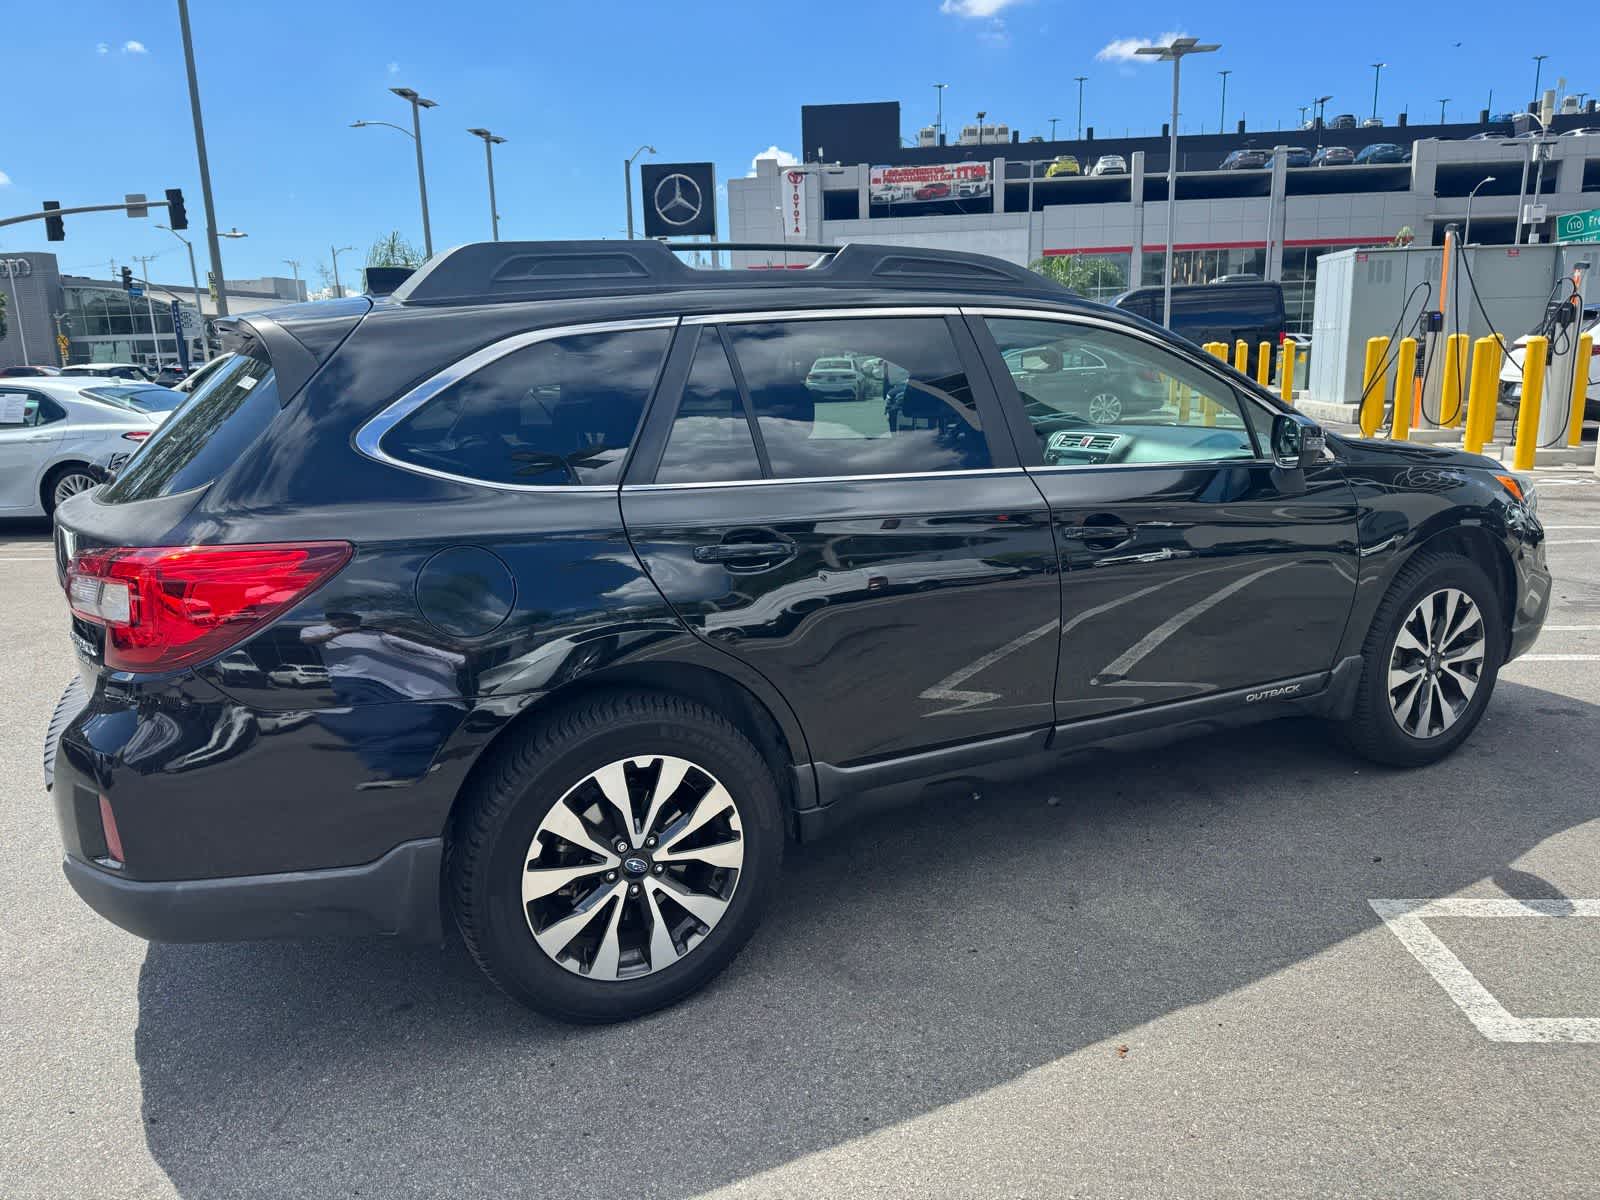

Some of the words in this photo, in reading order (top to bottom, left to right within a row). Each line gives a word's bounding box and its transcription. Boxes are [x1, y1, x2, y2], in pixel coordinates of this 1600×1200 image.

[792, 185, 800, 233] TOYOTA
[1570, 220, 1582, 230] 110
[1246, 684, 1301, 702] OUTBACK
